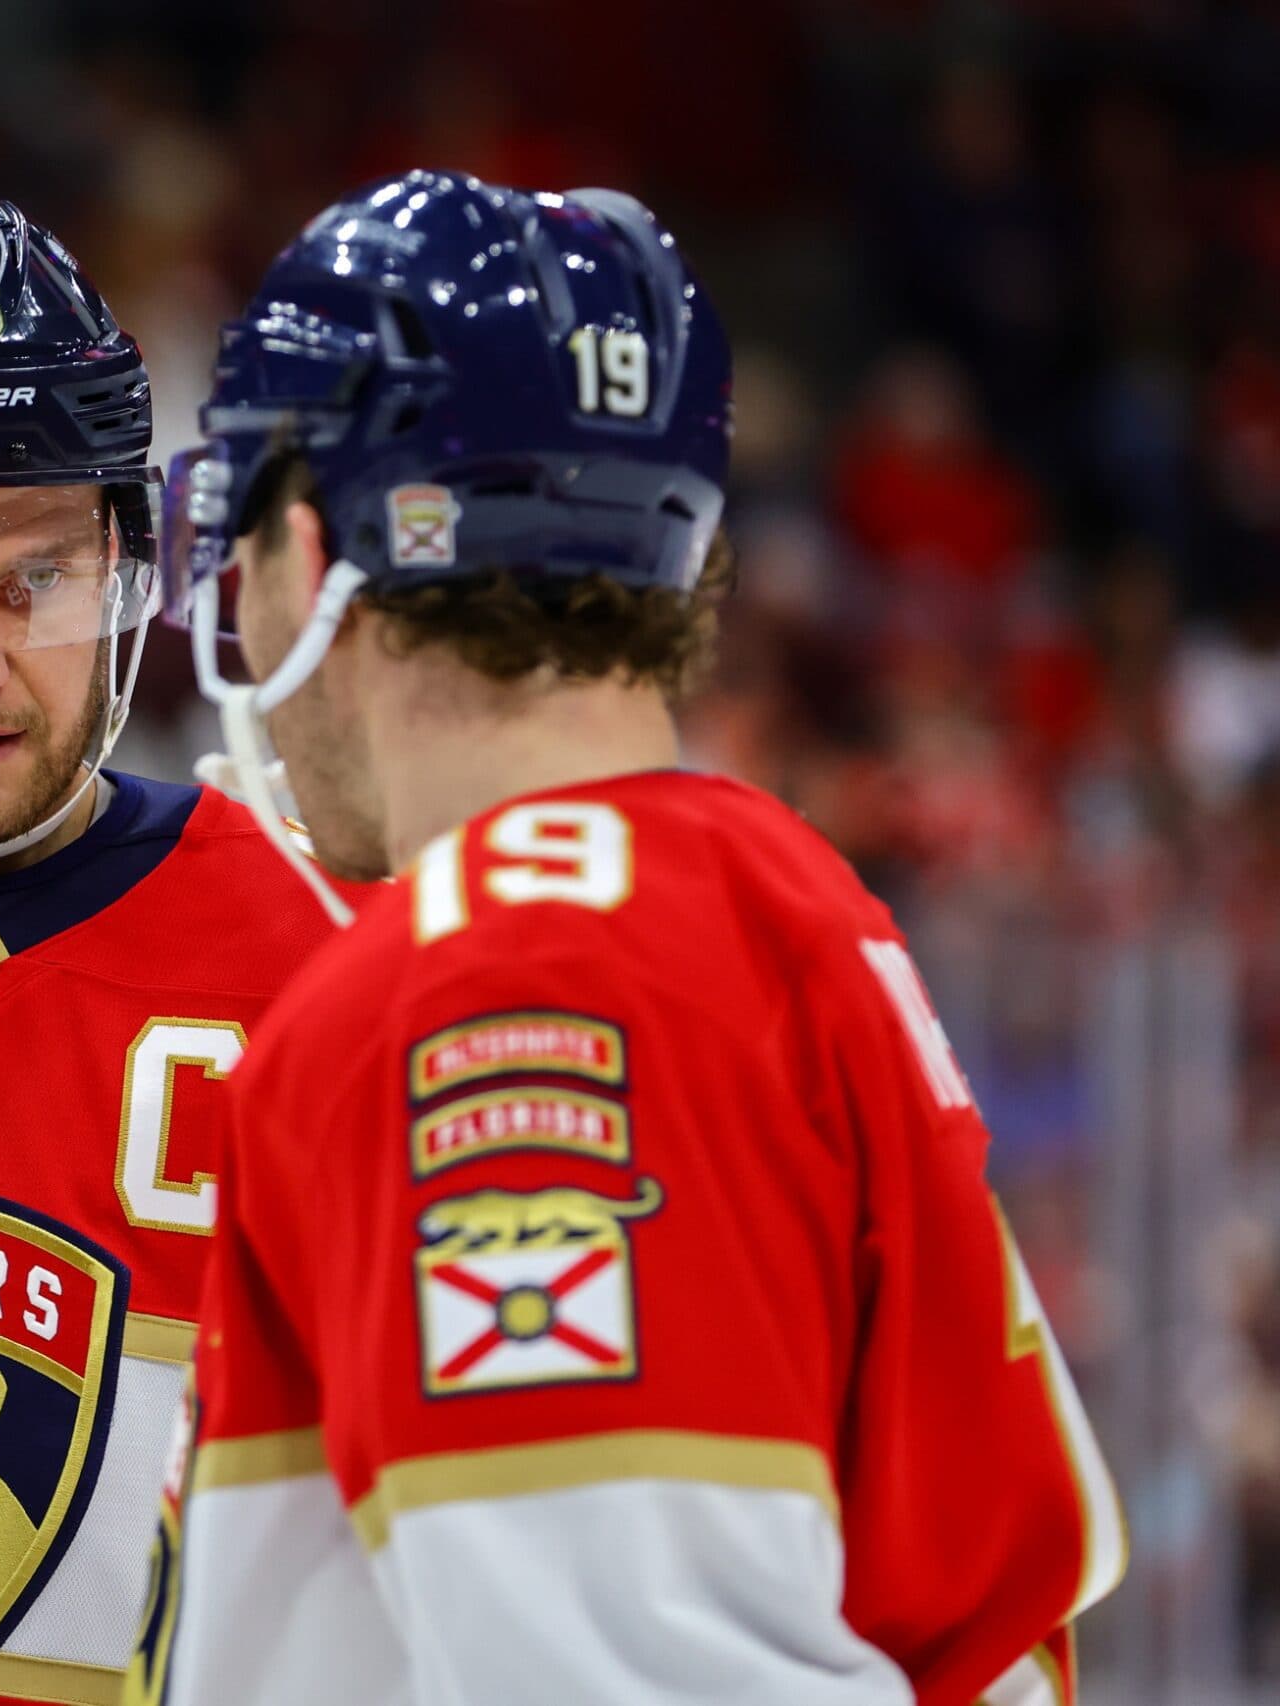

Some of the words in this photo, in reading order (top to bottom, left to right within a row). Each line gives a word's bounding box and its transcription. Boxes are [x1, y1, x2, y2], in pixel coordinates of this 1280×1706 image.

[570, 329, 650, 418] 19
[413, 800, 633, 945] 19
[114, 1016, 249, 1236] C
[434, 1101, 605, 1152] FLORIDA
